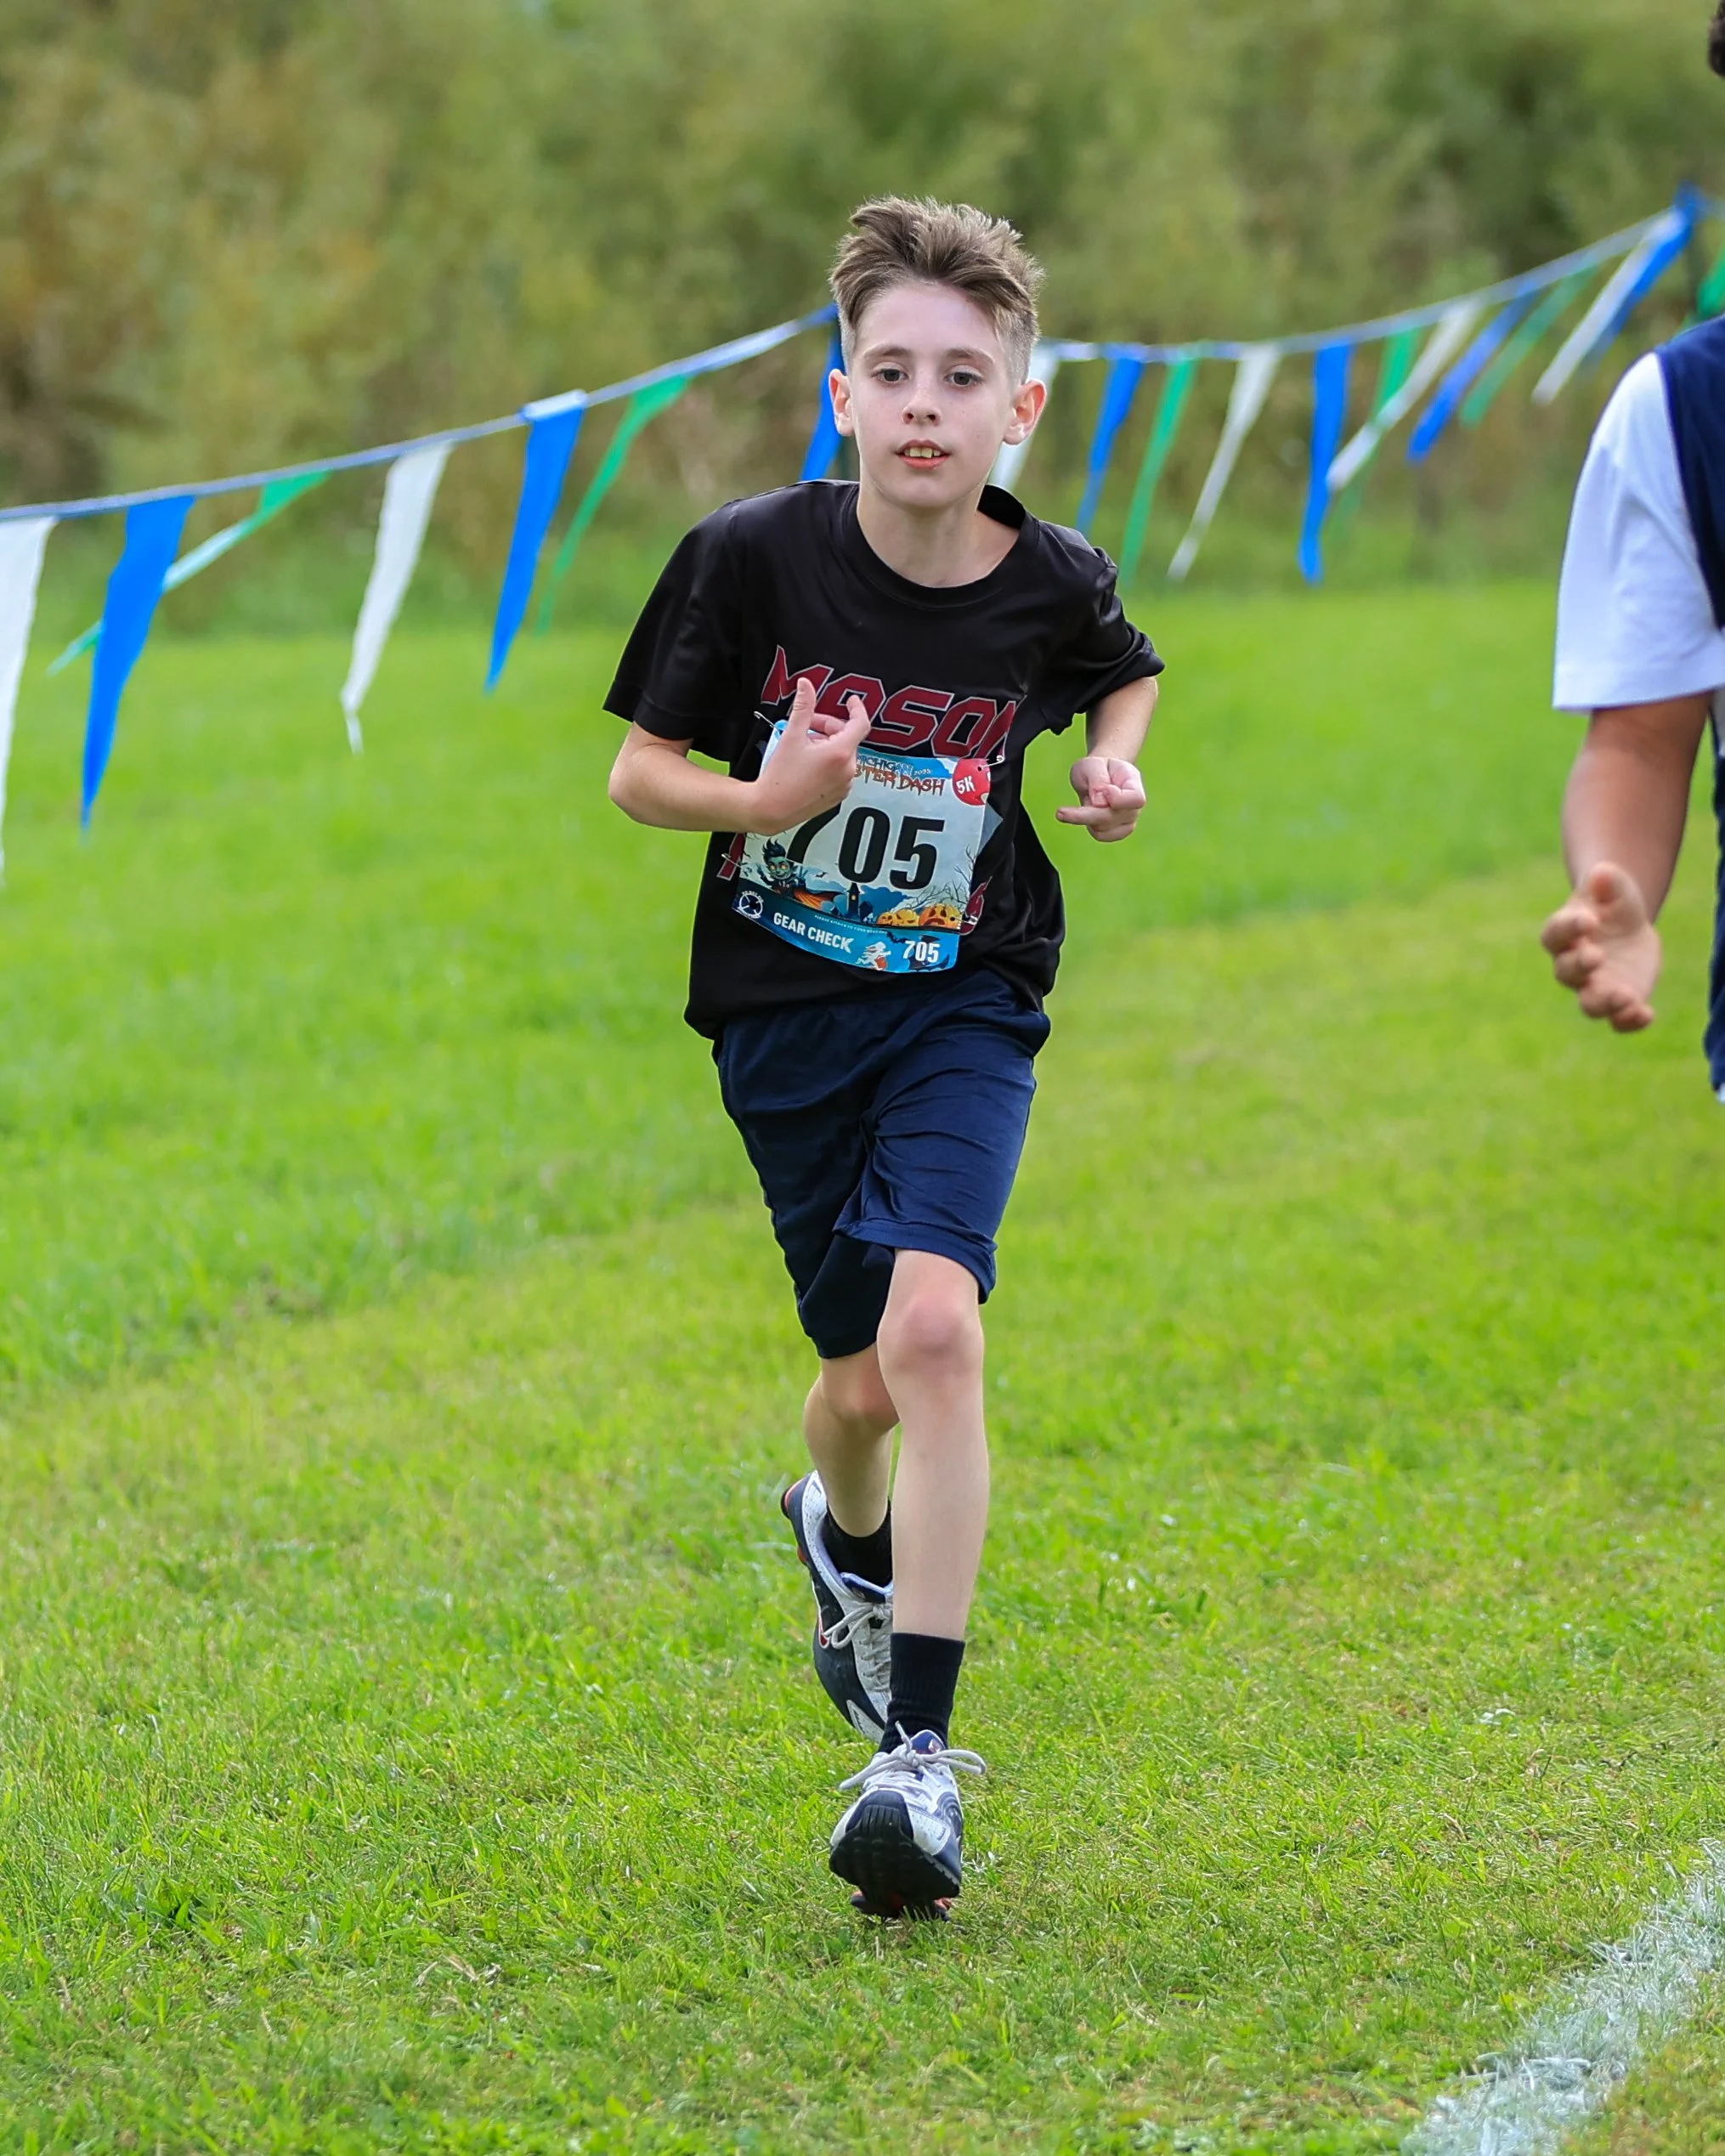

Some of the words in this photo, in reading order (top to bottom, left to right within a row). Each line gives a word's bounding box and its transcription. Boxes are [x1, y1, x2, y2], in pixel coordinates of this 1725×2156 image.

[853, 764, 896, 789] STER
[896, 774, 946, 796] DASH
[956, 776, 976, 794] 5K
[786, 802, 945, 890] 705
[773, 912, 806, 936] GEAR
[807, 926, 855, 954] CHECK
[902, 940, 940, 963] 705
